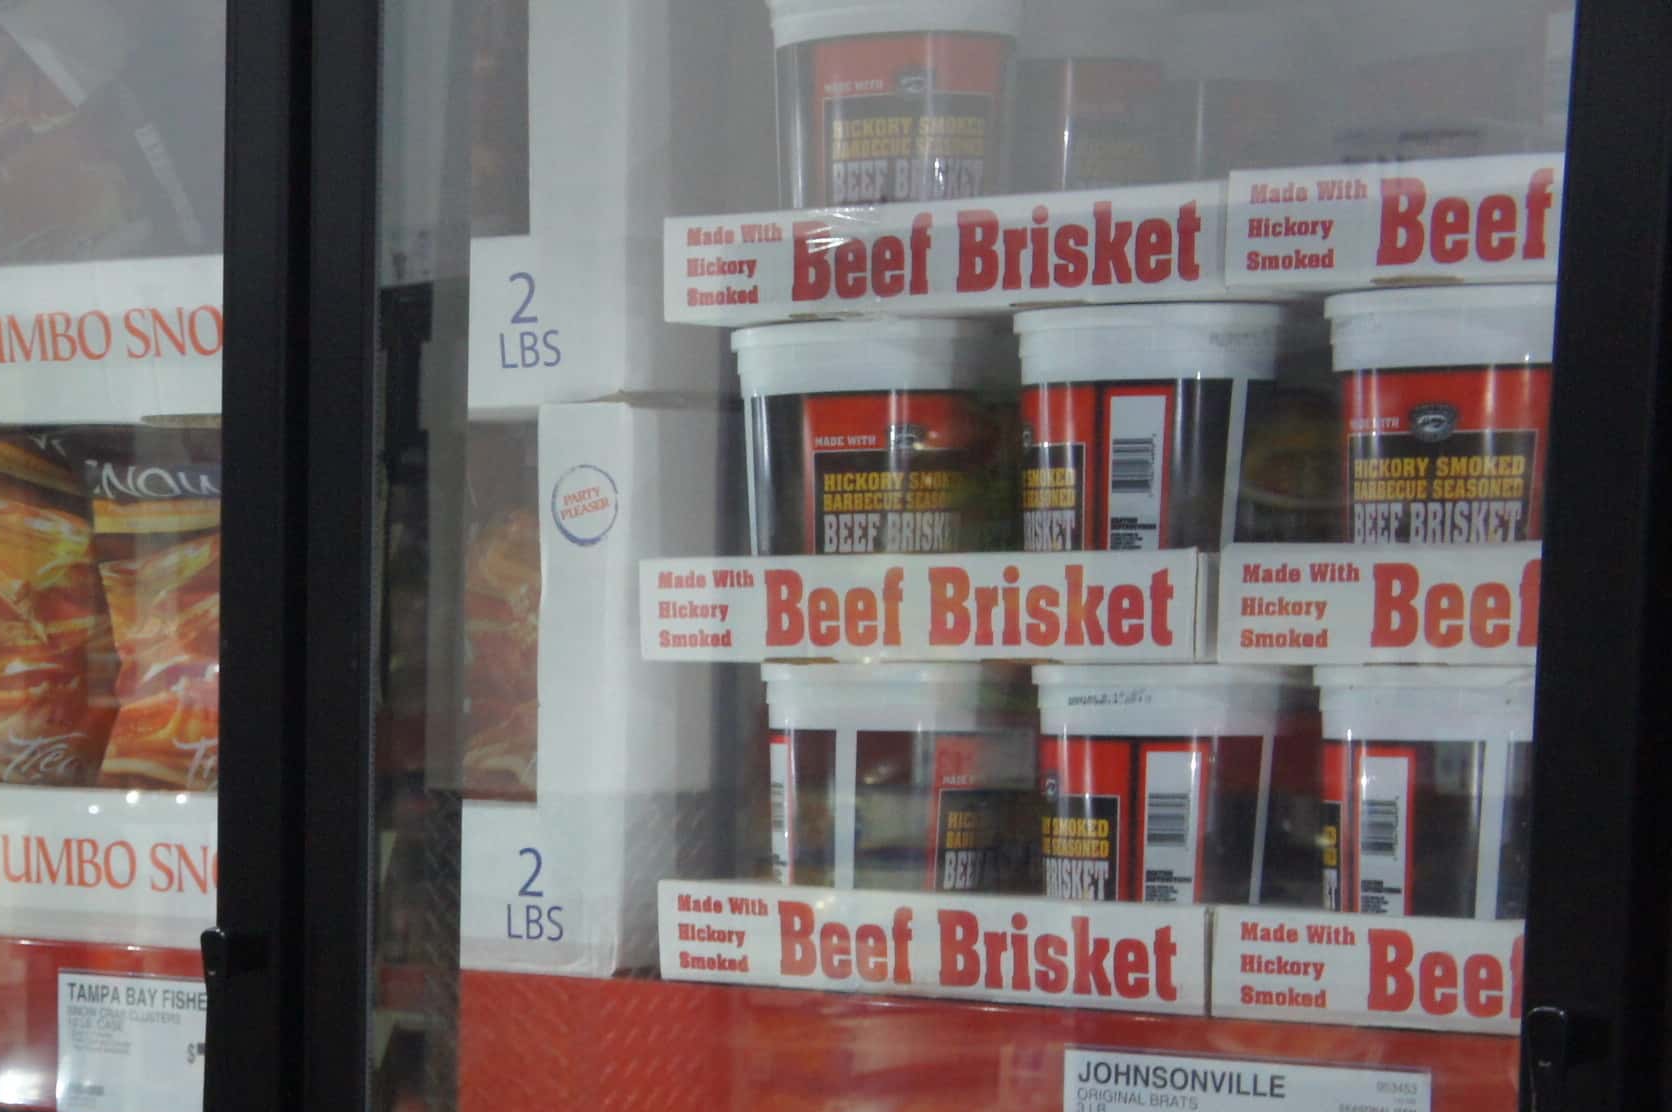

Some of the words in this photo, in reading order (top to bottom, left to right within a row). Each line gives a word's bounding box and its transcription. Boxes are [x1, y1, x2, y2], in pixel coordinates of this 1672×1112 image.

[832, 117, 913, 137] HICKORY
[832, 160, 889, 204] BEEF
[1249, 183, 1308, 205] Made
[1316, 179, 1368, 201] With
[1376, 167, 1554, 266] Beef
[686, 226, 735, 247] Made
[740, 223, 783, 244] With
[1248, 218, 1334, 240] Hickory
[792, 212, 933, 302] Beef
[957, 200, 1201, 293] Brisket
[1246, 249, 1334, 271] Smoked
[686, 258, 758, 279] Hickory
[509, 272, 538, 325] 2
[686, 286, 759, 307] Smoked
[123, 304, 223, 360] SNO
[499, 329, 561, 369] LBS
[847, 435, 876, 447] WITH
[1354, 458, 1429, 479] HICKORY
[1435, 456, 1526, 476] SMOKED
[824, 471, 905, 492] HICKORY
[1353, 479, 1428, 501] BARBECUE
[1432, 478, 1525, 499] SEASONED
[562, 486, 602, 506] PARTY
[824, 492, 904, 512] BARBECUE
[560, 497, 609, 521] PLEASER
[824, 513, 880, 552] BEEF
[883, 512, 960, 552] BRISK
[1023, 511, 1076, 552] RISKET
[1354, 502, 1402, 545] BEEF
[1410, 501, 1524, 544] BRISKET
[658, 571, 707, 590] Made
[712, 569, 755, 588] With
[1242, 564, 1301, 584] Made
[1309, 563, 1360, 583] With
[658, 602, 729, 623] Hickory
[765, 566, 905, 648] Beef
[928, 563, 1175, 648] Brisket
[1241, 597, 1327, 620] Hickory
[659, 629, 733, 649] Smoked
[1240, 628, 1328, 650] Smoked
[149, 842, 217, 896] SN
[518, 847, 544, 897] 2
[677, 894, 724, 914] Made
[728, 897, 769, 917] With
[507, 903, 564, 942] LBS
[1240, 922, 1299, 943] Made
[1306, 924, 1356, 946] With
[678, 924, 746, 948] Hickory
[679, 952, 750, 974] Smoked
[777, 900, 914, 985] Beef
[937, 908, 1178, 1002] Brisket
[1240, 955, 1326, 981] Hickory
[67, 982, 121, 1004] TAMPA
[126, 987, 158, 1008] BAY
[162, 990, 207, 1012] FISHE
[1240, 985, 1328, 1009] Smoked
[1078, 1062, 1286, 1098] JOHNSONVILLE
[1077, 1087, 1146, 1107] ORIGINAL
[1150, 1092, 1199, 1111] BRATS
